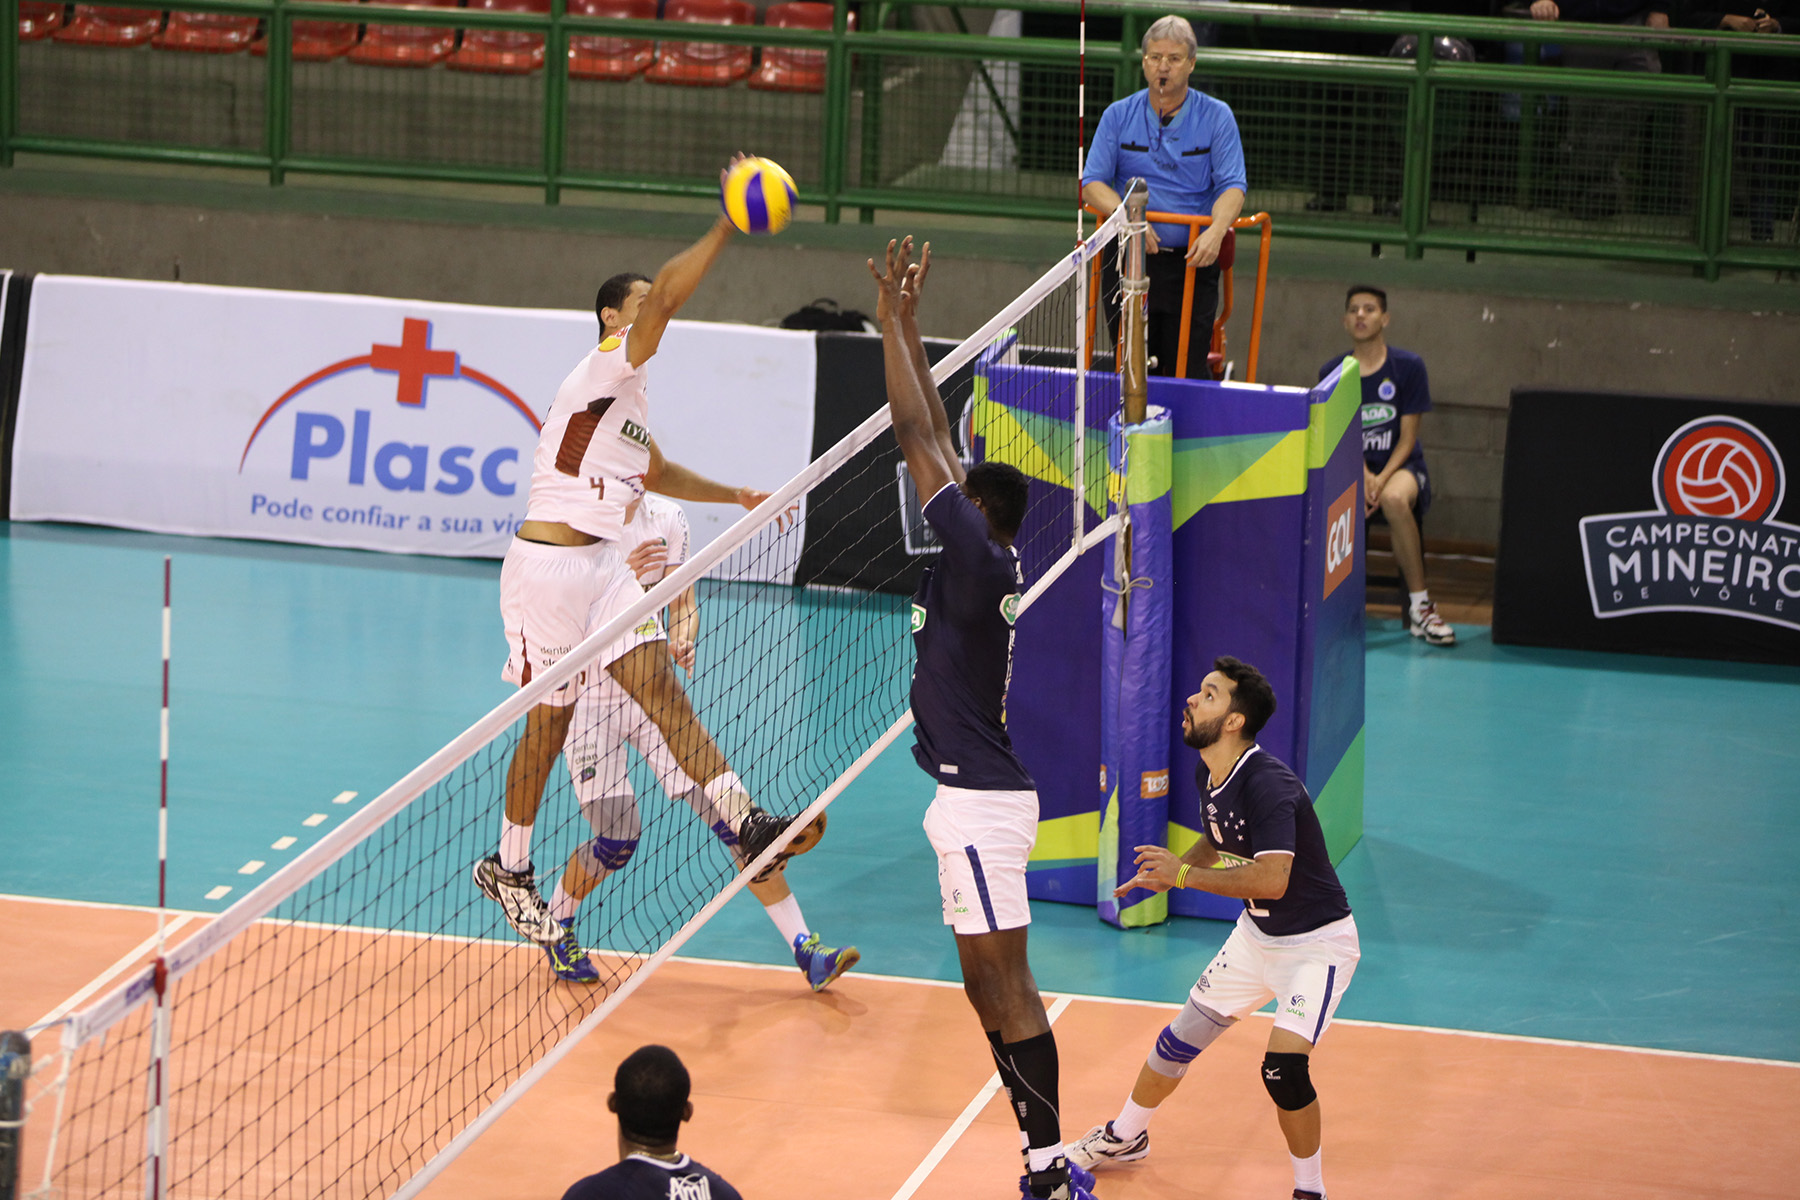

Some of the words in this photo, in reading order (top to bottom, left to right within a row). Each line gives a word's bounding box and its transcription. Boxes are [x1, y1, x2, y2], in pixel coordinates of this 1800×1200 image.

[289, 409, 520, 497] Plasc
[589, 477, 605, 500] 4
[250, 494, 313, 521] Pode
[322, 506, 410, 531] confiar
[418, 516, 432, 532] a
[440, 518, 483, 534] sua
[1327, 507, 1353, 574] GOL
[1605, 523, 1800, 558] CAMPEONAT
[1608, 548, 1800, 598] MINEIRO
[1612, 586, 1650, 603] DE
[540, 644, 572, 655] dental
[1286, 1007, 1305, 1018] SADA
